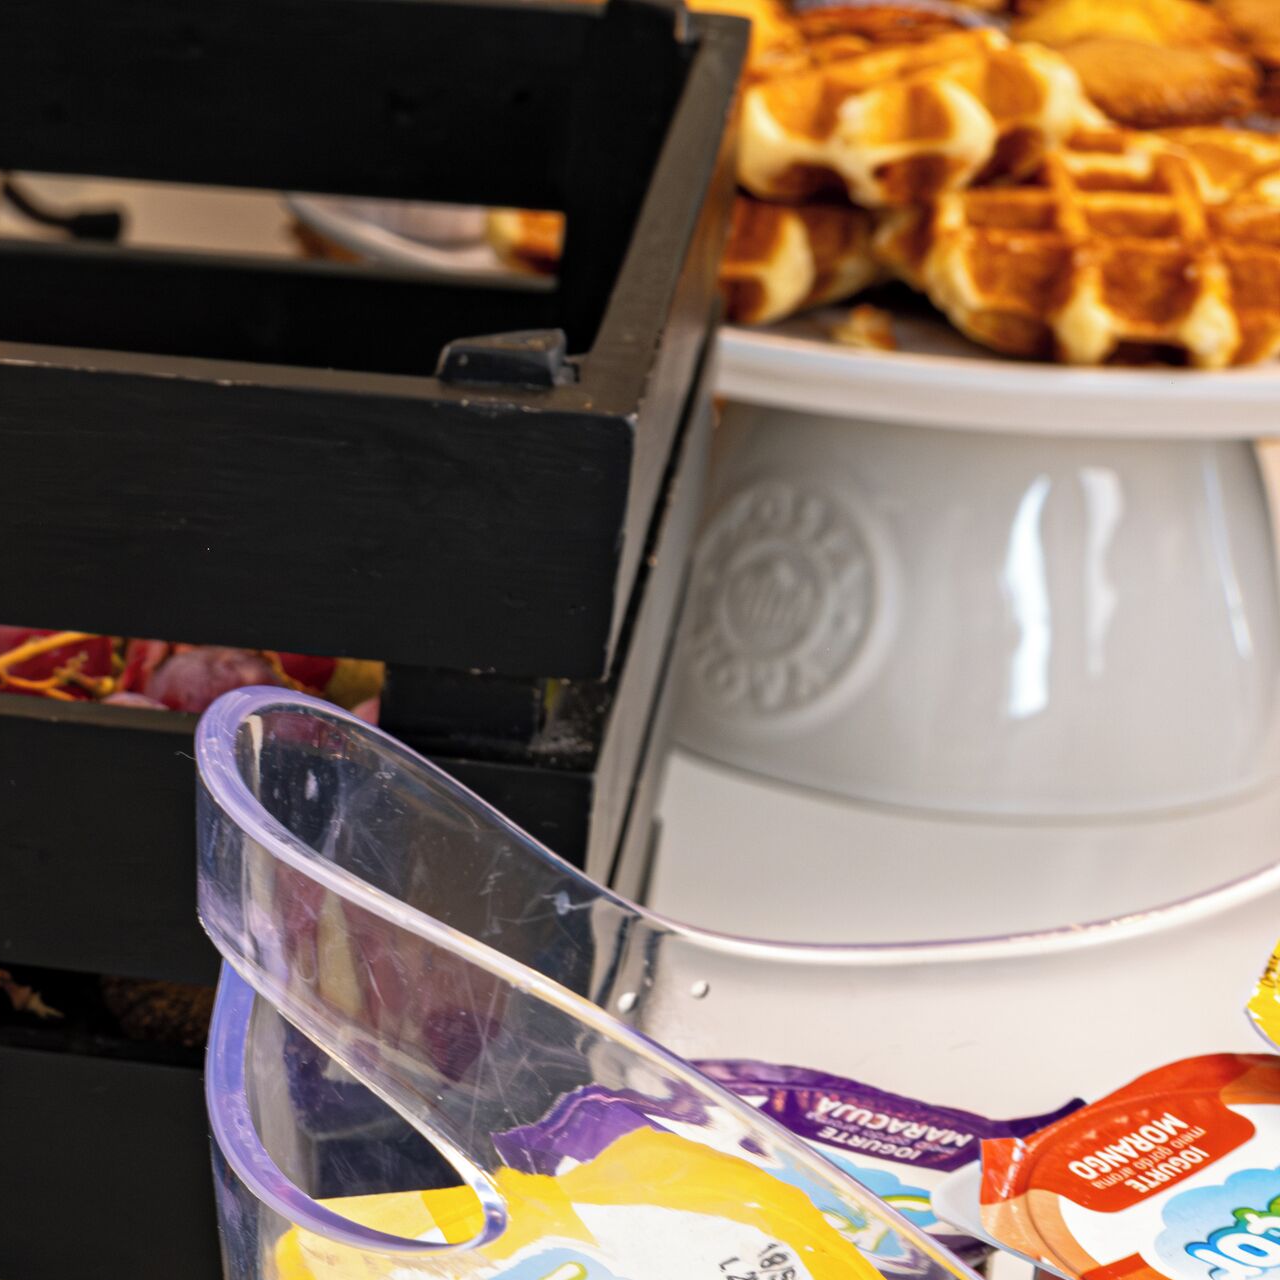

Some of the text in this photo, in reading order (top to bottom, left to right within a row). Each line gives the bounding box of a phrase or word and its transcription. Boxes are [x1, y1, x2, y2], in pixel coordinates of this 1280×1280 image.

[816, 1126, 923, 1160] IOGURTE
[1068, 1112, 1189, 1180] MORANGO
[1170, 1126, 1207, 1149] meio
[1091, 1166, 1137, 1190] aroma
[1124, 1145, 1210, 1193] IOGURTE
